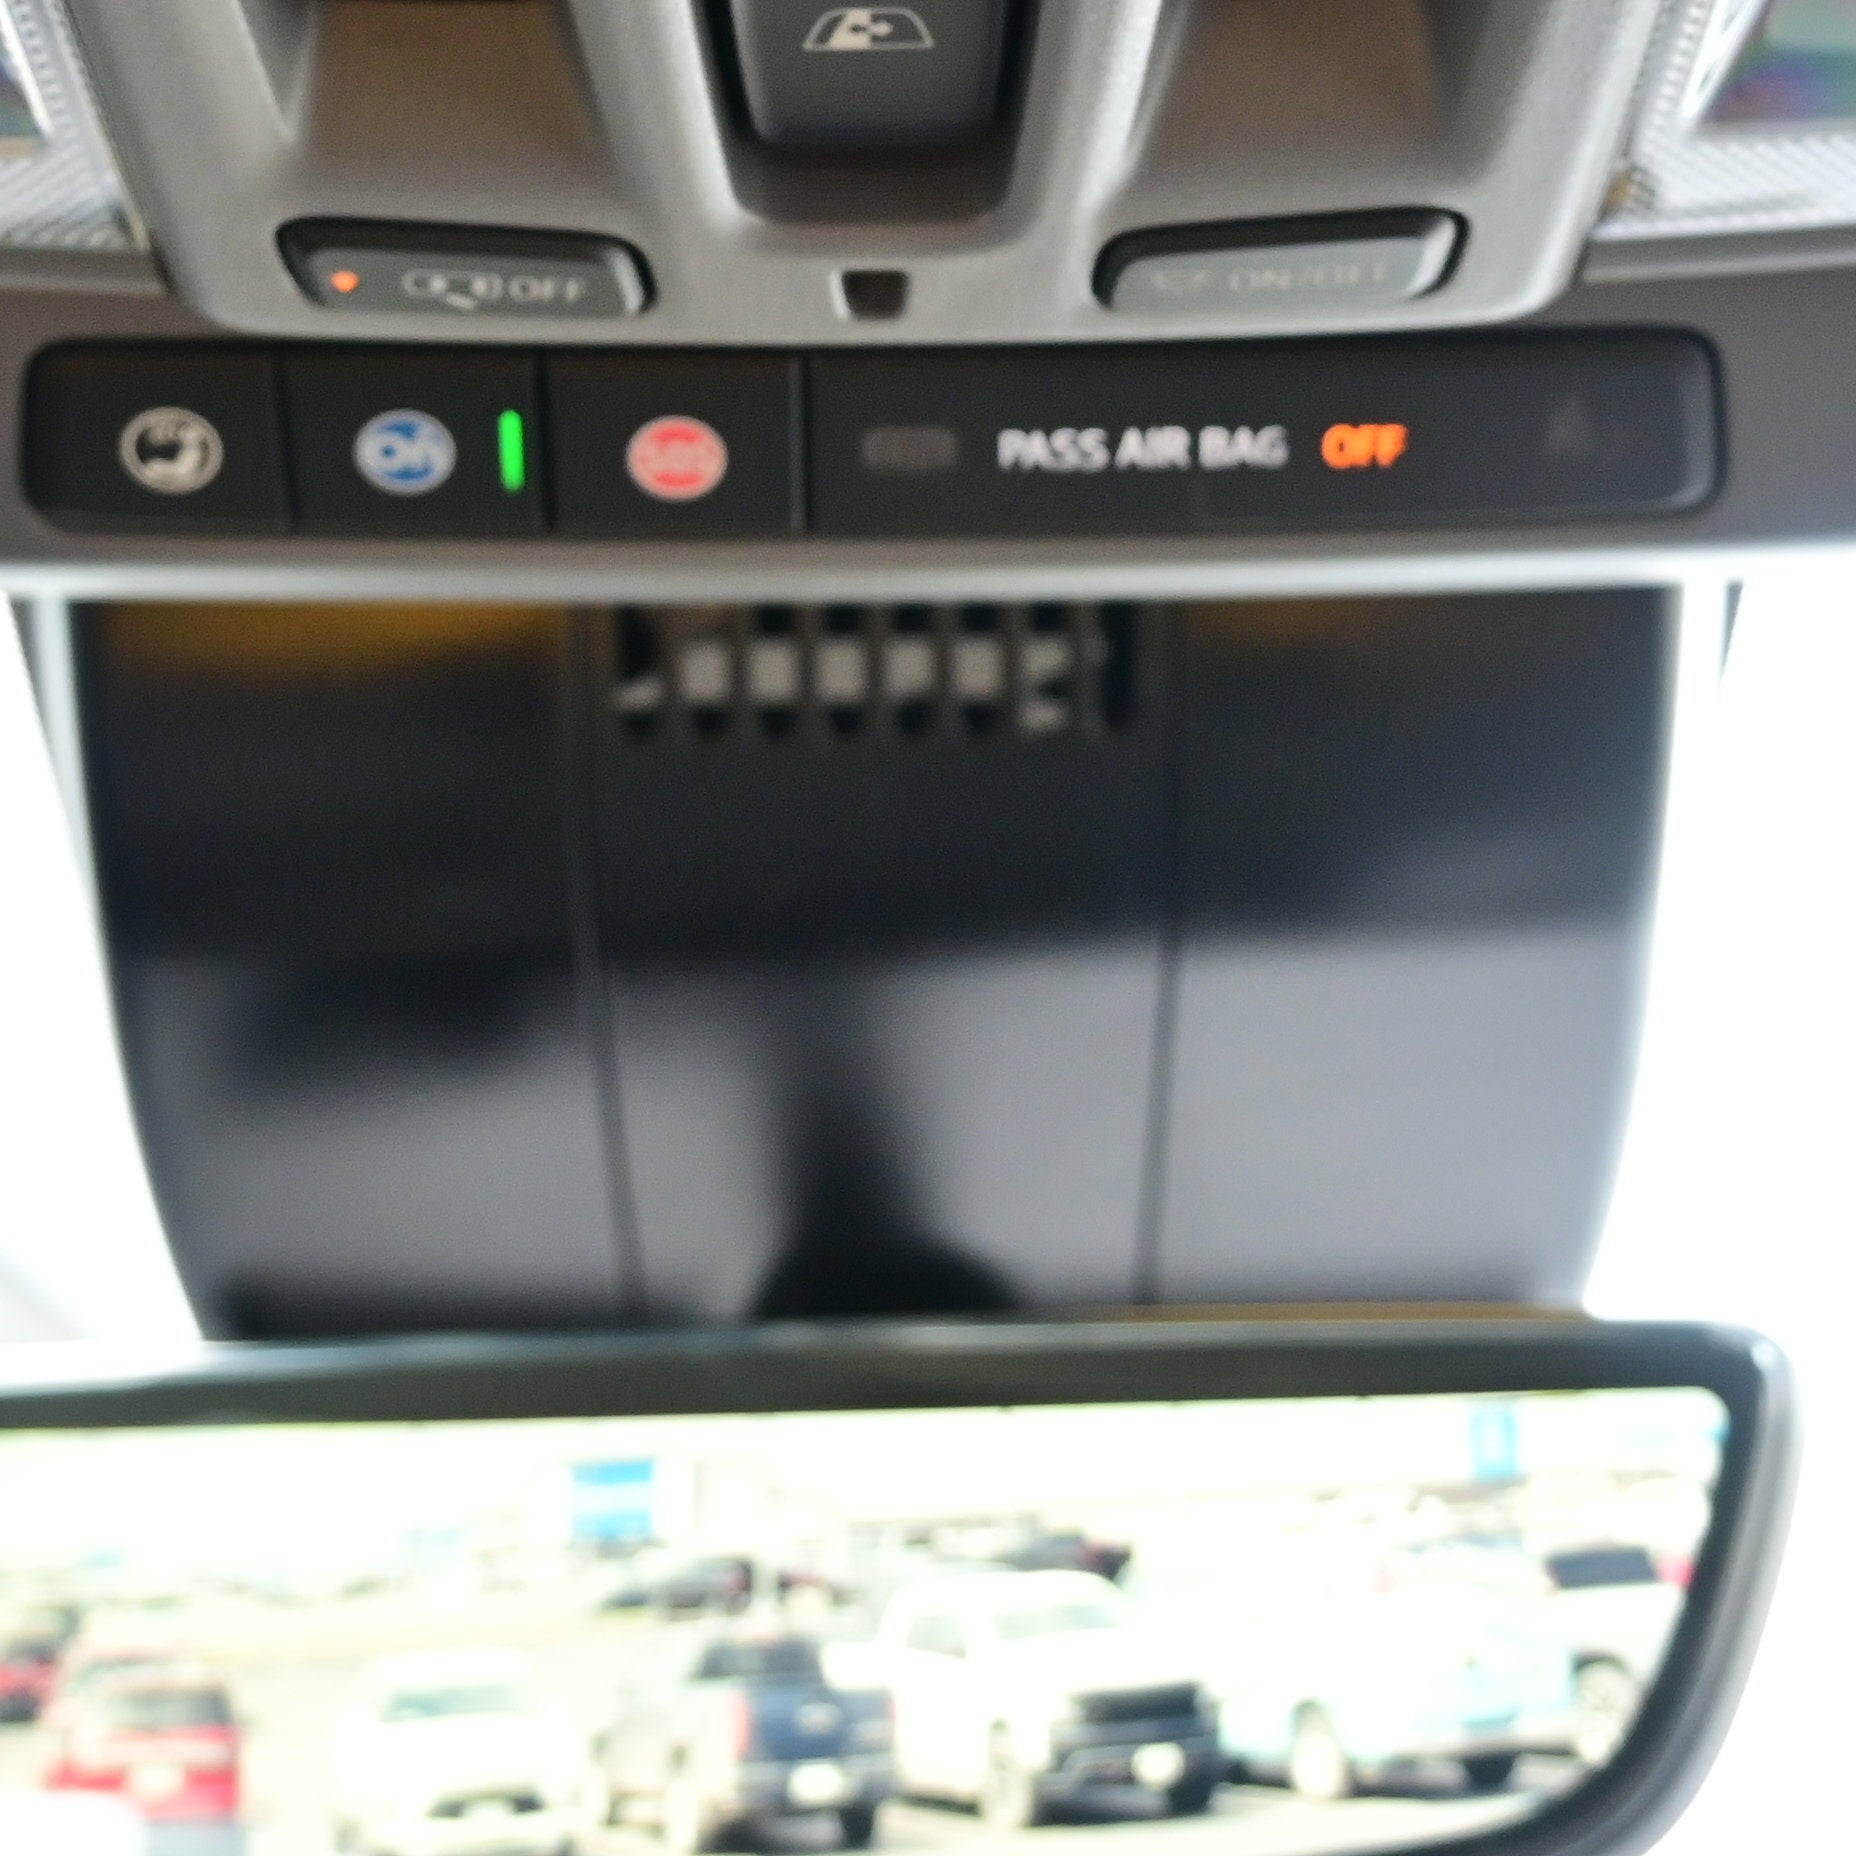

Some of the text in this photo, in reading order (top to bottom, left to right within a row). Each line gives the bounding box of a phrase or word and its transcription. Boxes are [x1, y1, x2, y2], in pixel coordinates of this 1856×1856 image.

[997, 427, 1111, 472] PASS
[1115, 425, 1193, 470] AIR
[1198, 424, 1291, 471] BAG
[1320, 422, 1409, 470] OFF
